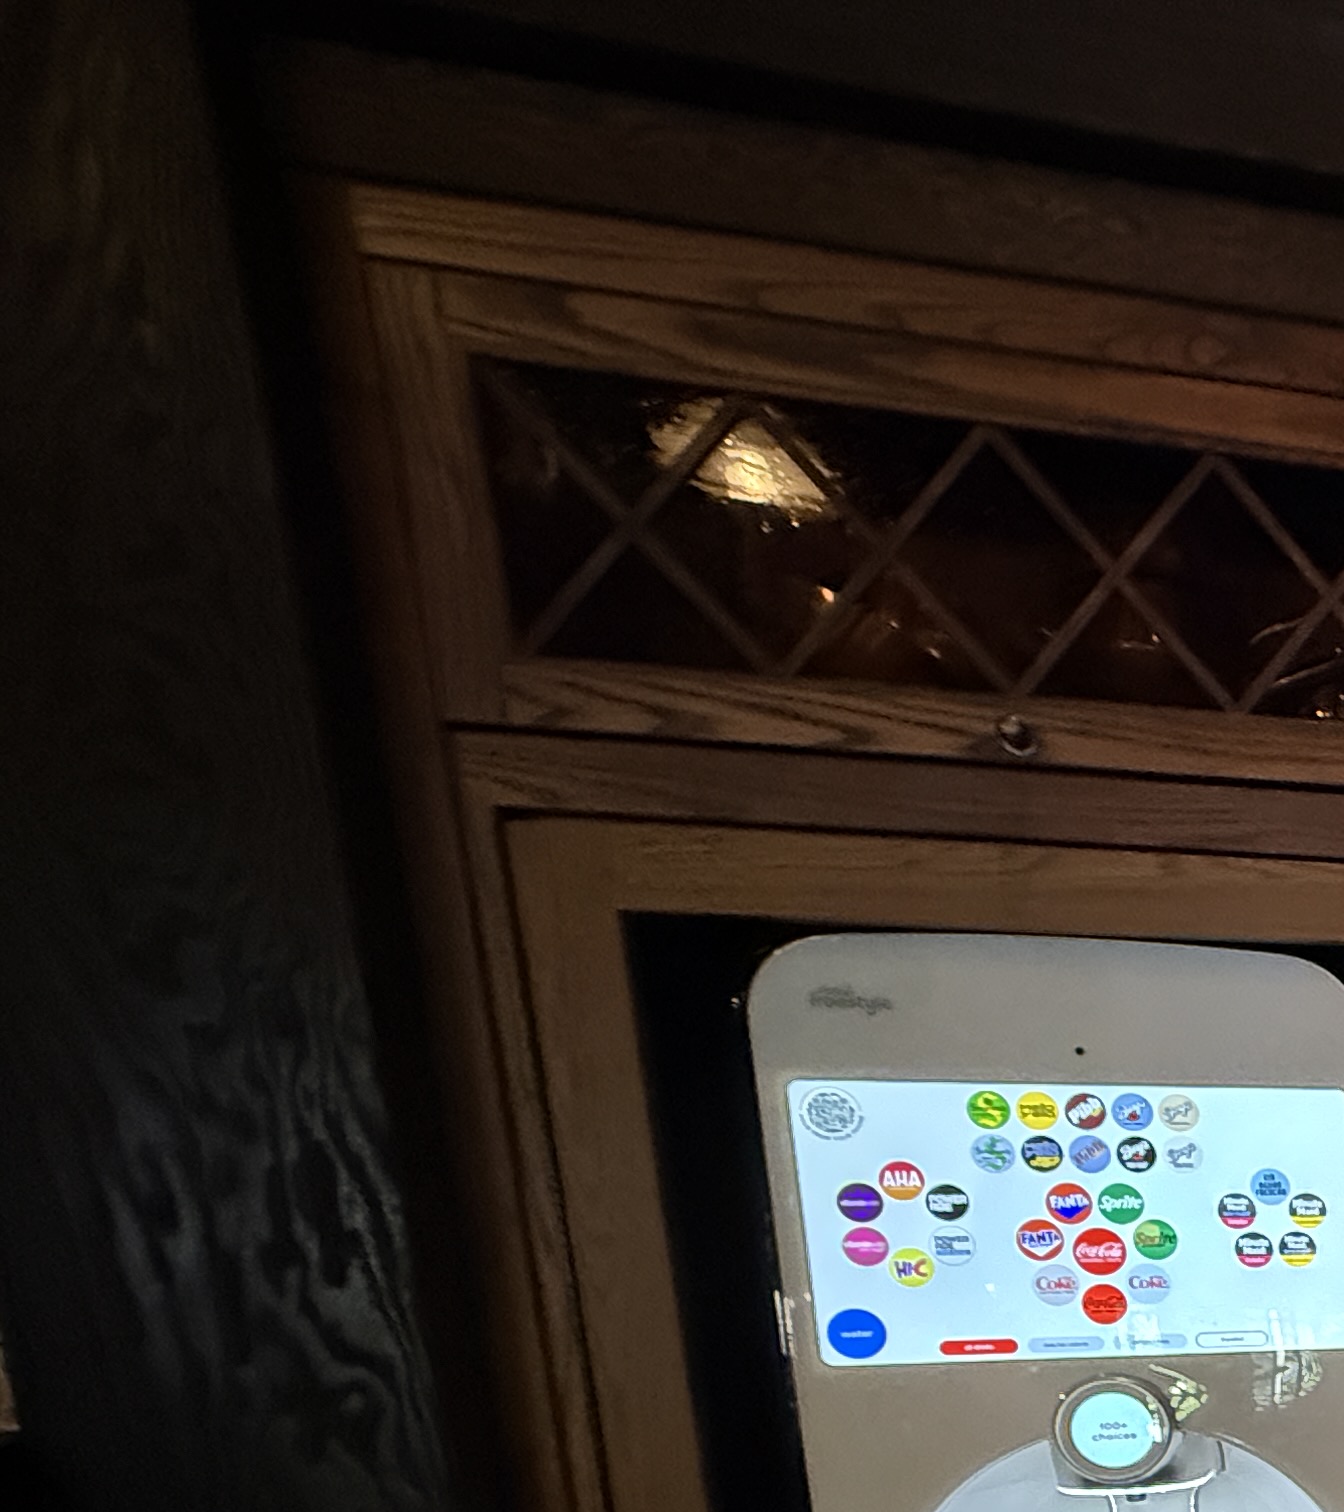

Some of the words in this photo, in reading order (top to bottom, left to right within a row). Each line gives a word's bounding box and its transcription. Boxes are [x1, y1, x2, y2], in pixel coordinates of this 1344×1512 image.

[883, 1170, 922, 1187] AHA
[1099, 1195, 1142, 1212] Sprite
[1092, 1432, 1138, 1442] choices
